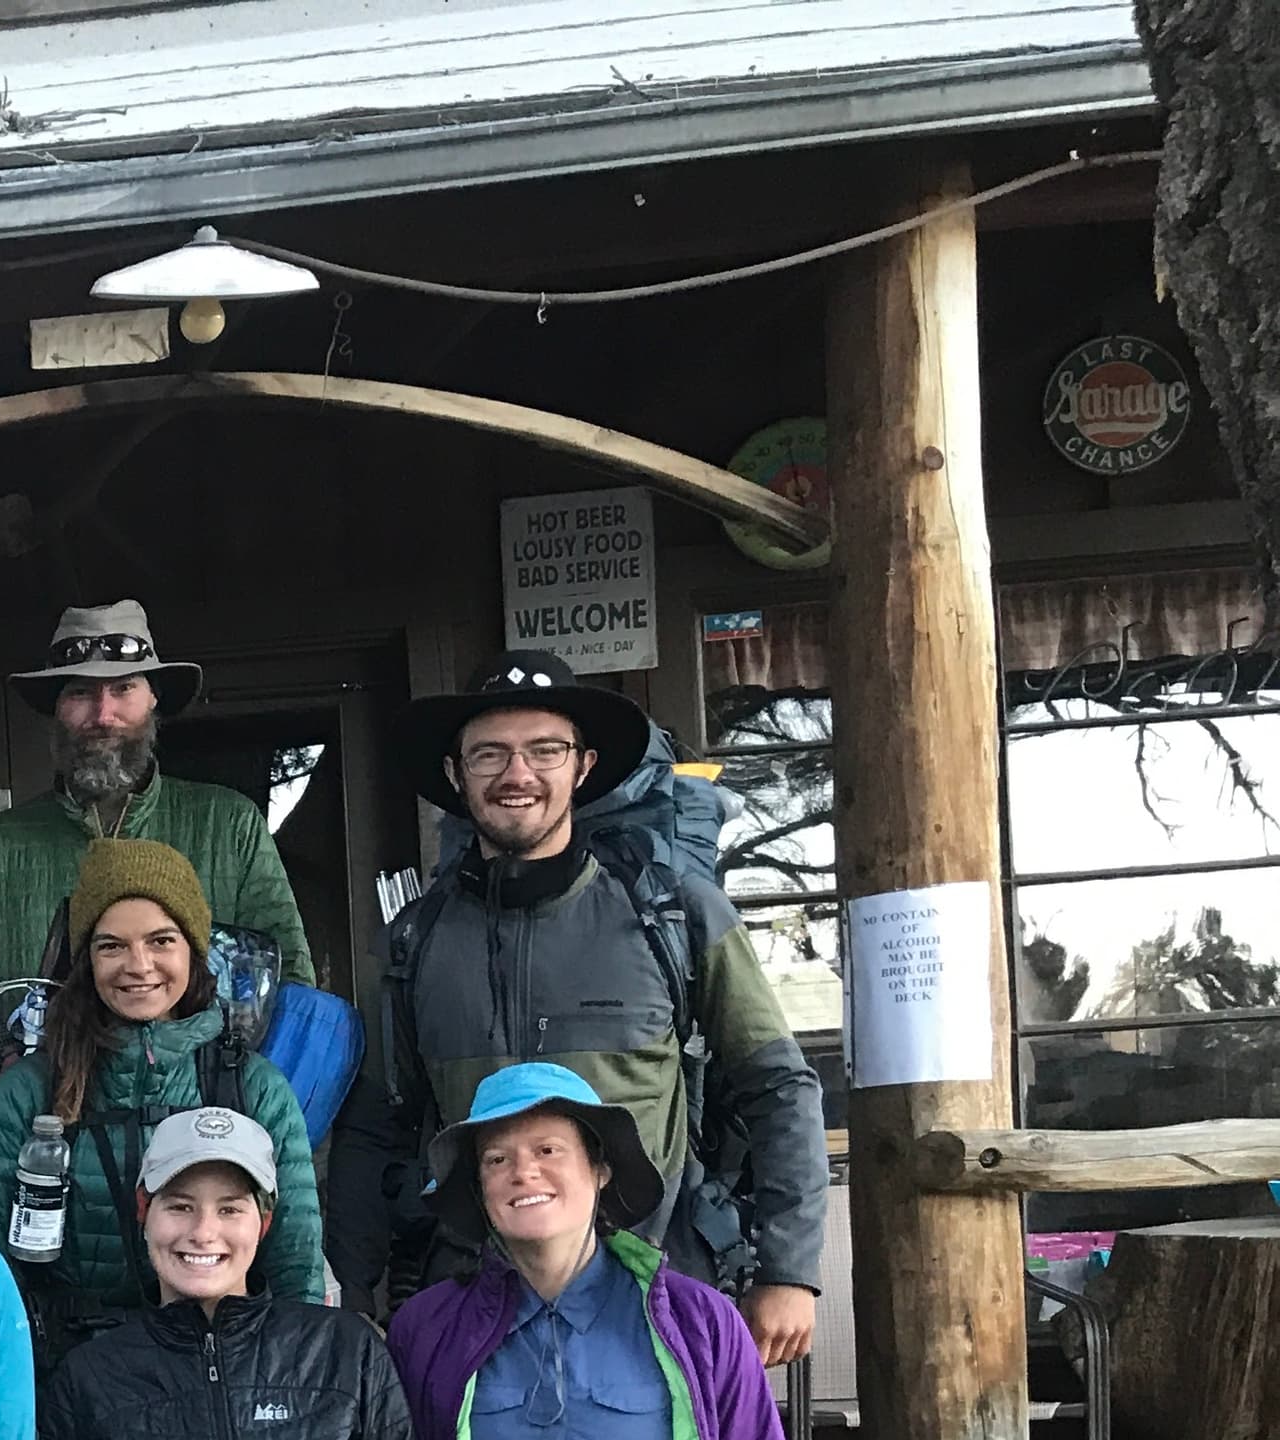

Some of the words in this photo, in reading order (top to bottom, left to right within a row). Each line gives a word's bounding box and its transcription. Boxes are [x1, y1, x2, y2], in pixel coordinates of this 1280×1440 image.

[1080, 342, 1153, 366] LAST
[1044, 370, 1189, 434] Garage
[1065, 432, 1170, 468] CHANCE
[527, 510, 569, 534] HOT
[576, 505, 627, 529] BEER
[513, 536, 576, 562] LOUSY
[584, 530, 642, 555] FOOD
[517, 565, 559, 588] BAD
[566, 556, 640, 584] SERVICE
[514, 598, 648, 639] WELCOME
[580, 642, 605, 656] NICE
[614, 639, 635, 653] DAY
[882, 909, 939, 922] CONTAIN
[901, 924, 920, 934] OF
[889, 951, 913, 962] MAY
[920, 950, 936, 960] BE
[882, 963, 943, 977] BROUGHT
[889, 981, 905, 990] ON
[912, 978, 936, 987] THE
[895, 991, 932, 1003] DECK
